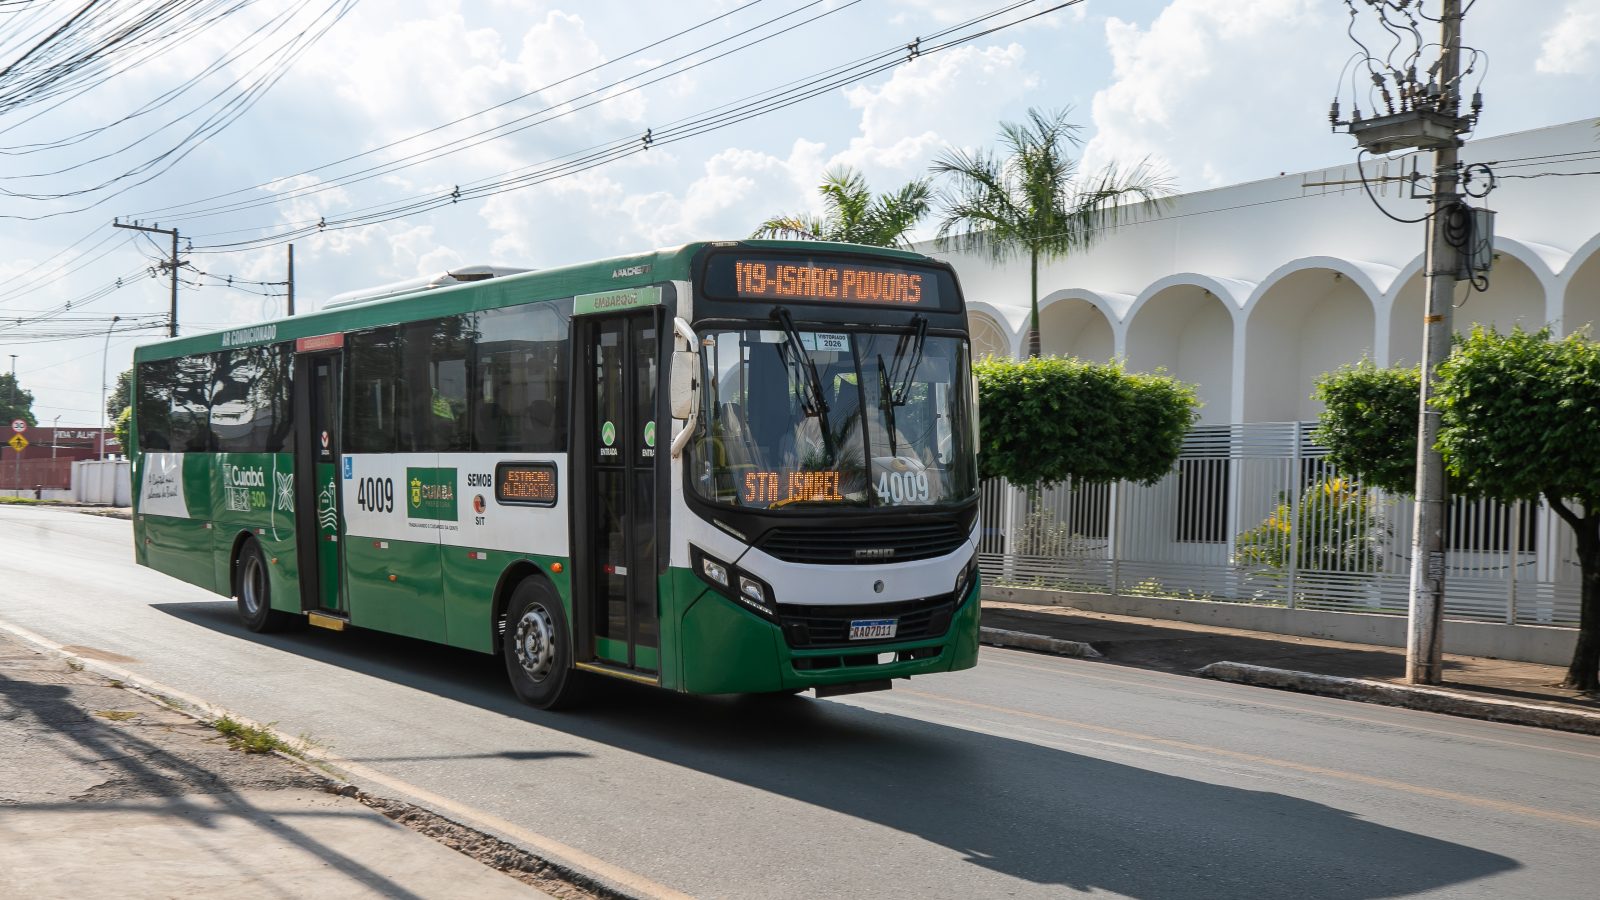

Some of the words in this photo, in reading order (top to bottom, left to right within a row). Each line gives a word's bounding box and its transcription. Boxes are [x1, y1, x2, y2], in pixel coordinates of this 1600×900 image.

[736, 262, 838, 297] 119-ISAAC
[843, 270, 922, 302] POVOAS
[593, 292, 638, 309] EMBARQUE
[600, 448, 618, 456] ENTRADA
[641, 449, 655, 457] ENTRA
[232, 465, 265, 487] Cuiabá
[467, 473, 492, 487] SEMOB
[357, 477, 394, 513] 4009
[745, 472, 779, 502] STA
[788, 471, 843, 500] ISABEL
[878, 471, 929, 503] 4009
[251, 491, 266, 507] 300
[475, 516, 486, 526] SIT
